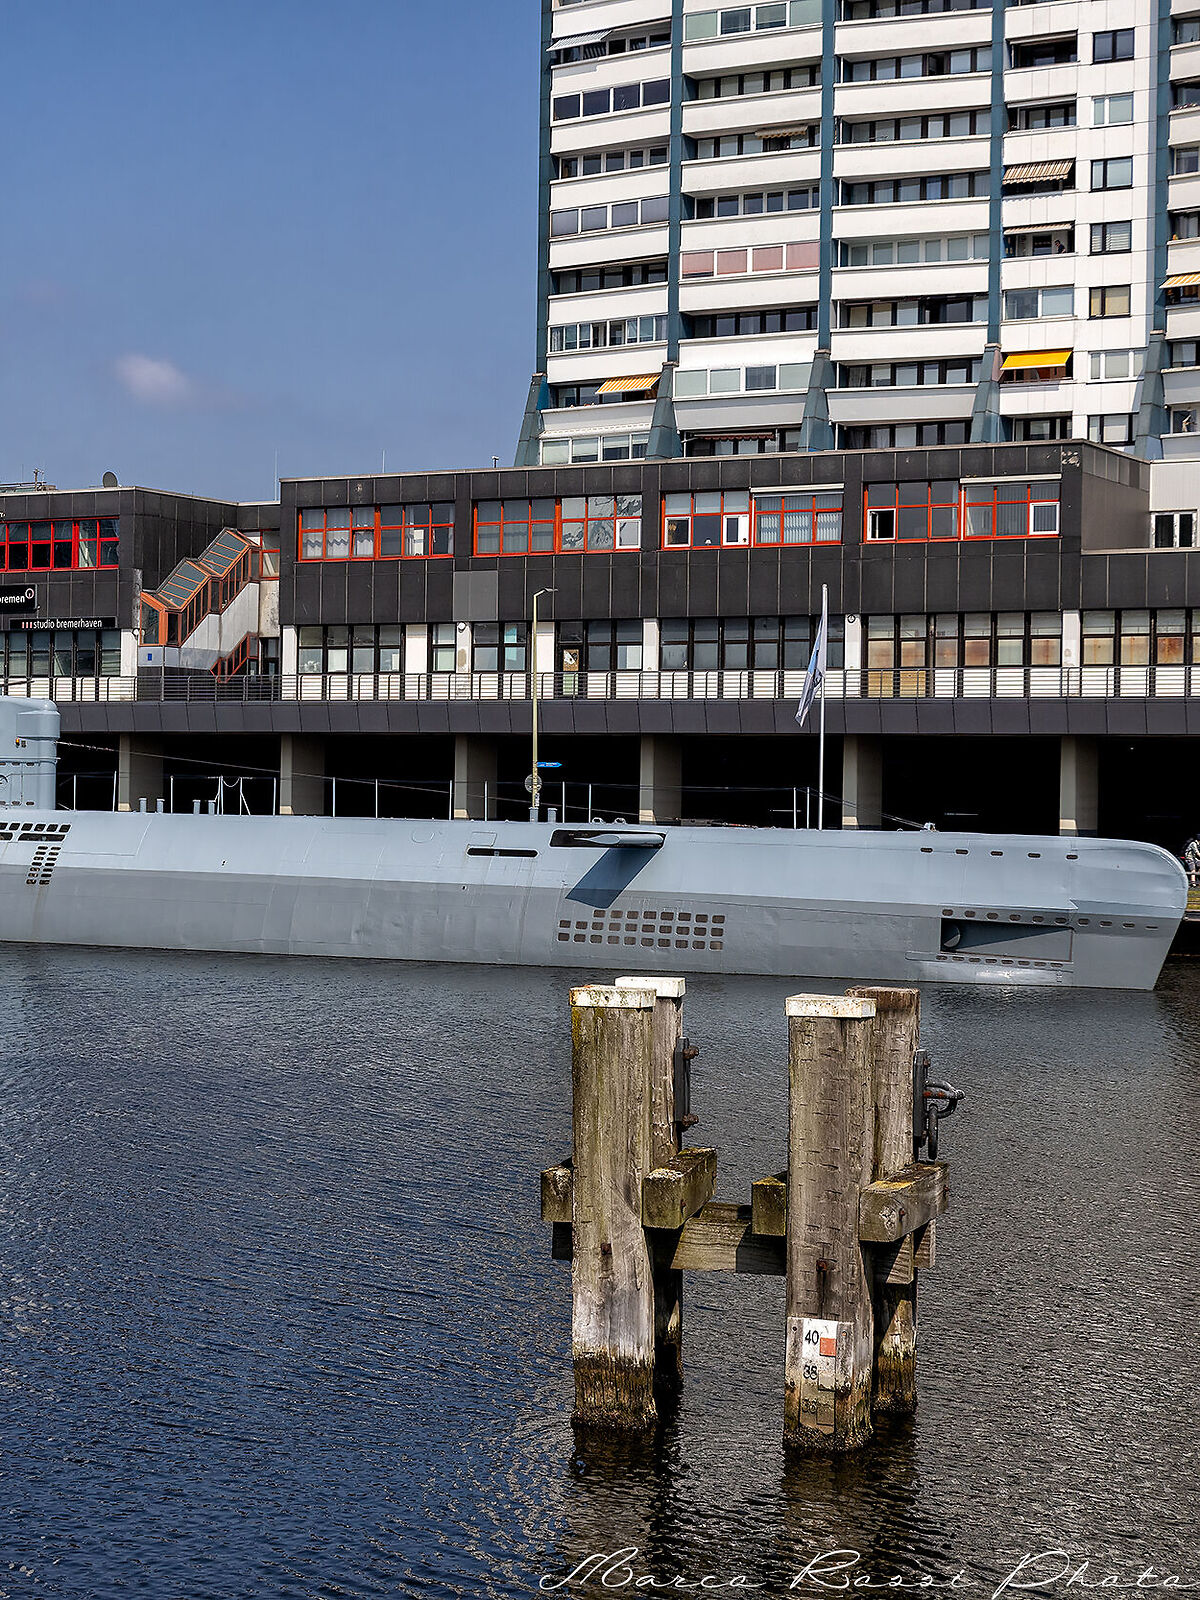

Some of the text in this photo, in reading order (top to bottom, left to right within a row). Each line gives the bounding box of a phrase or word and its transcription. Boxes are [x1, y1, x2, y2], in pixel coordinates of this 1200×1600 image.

[33, 618, 103, 629] studio bremerhaven
[805, 1329, 820, 1345] 40
[803, 1364, 818, 1381] 38
